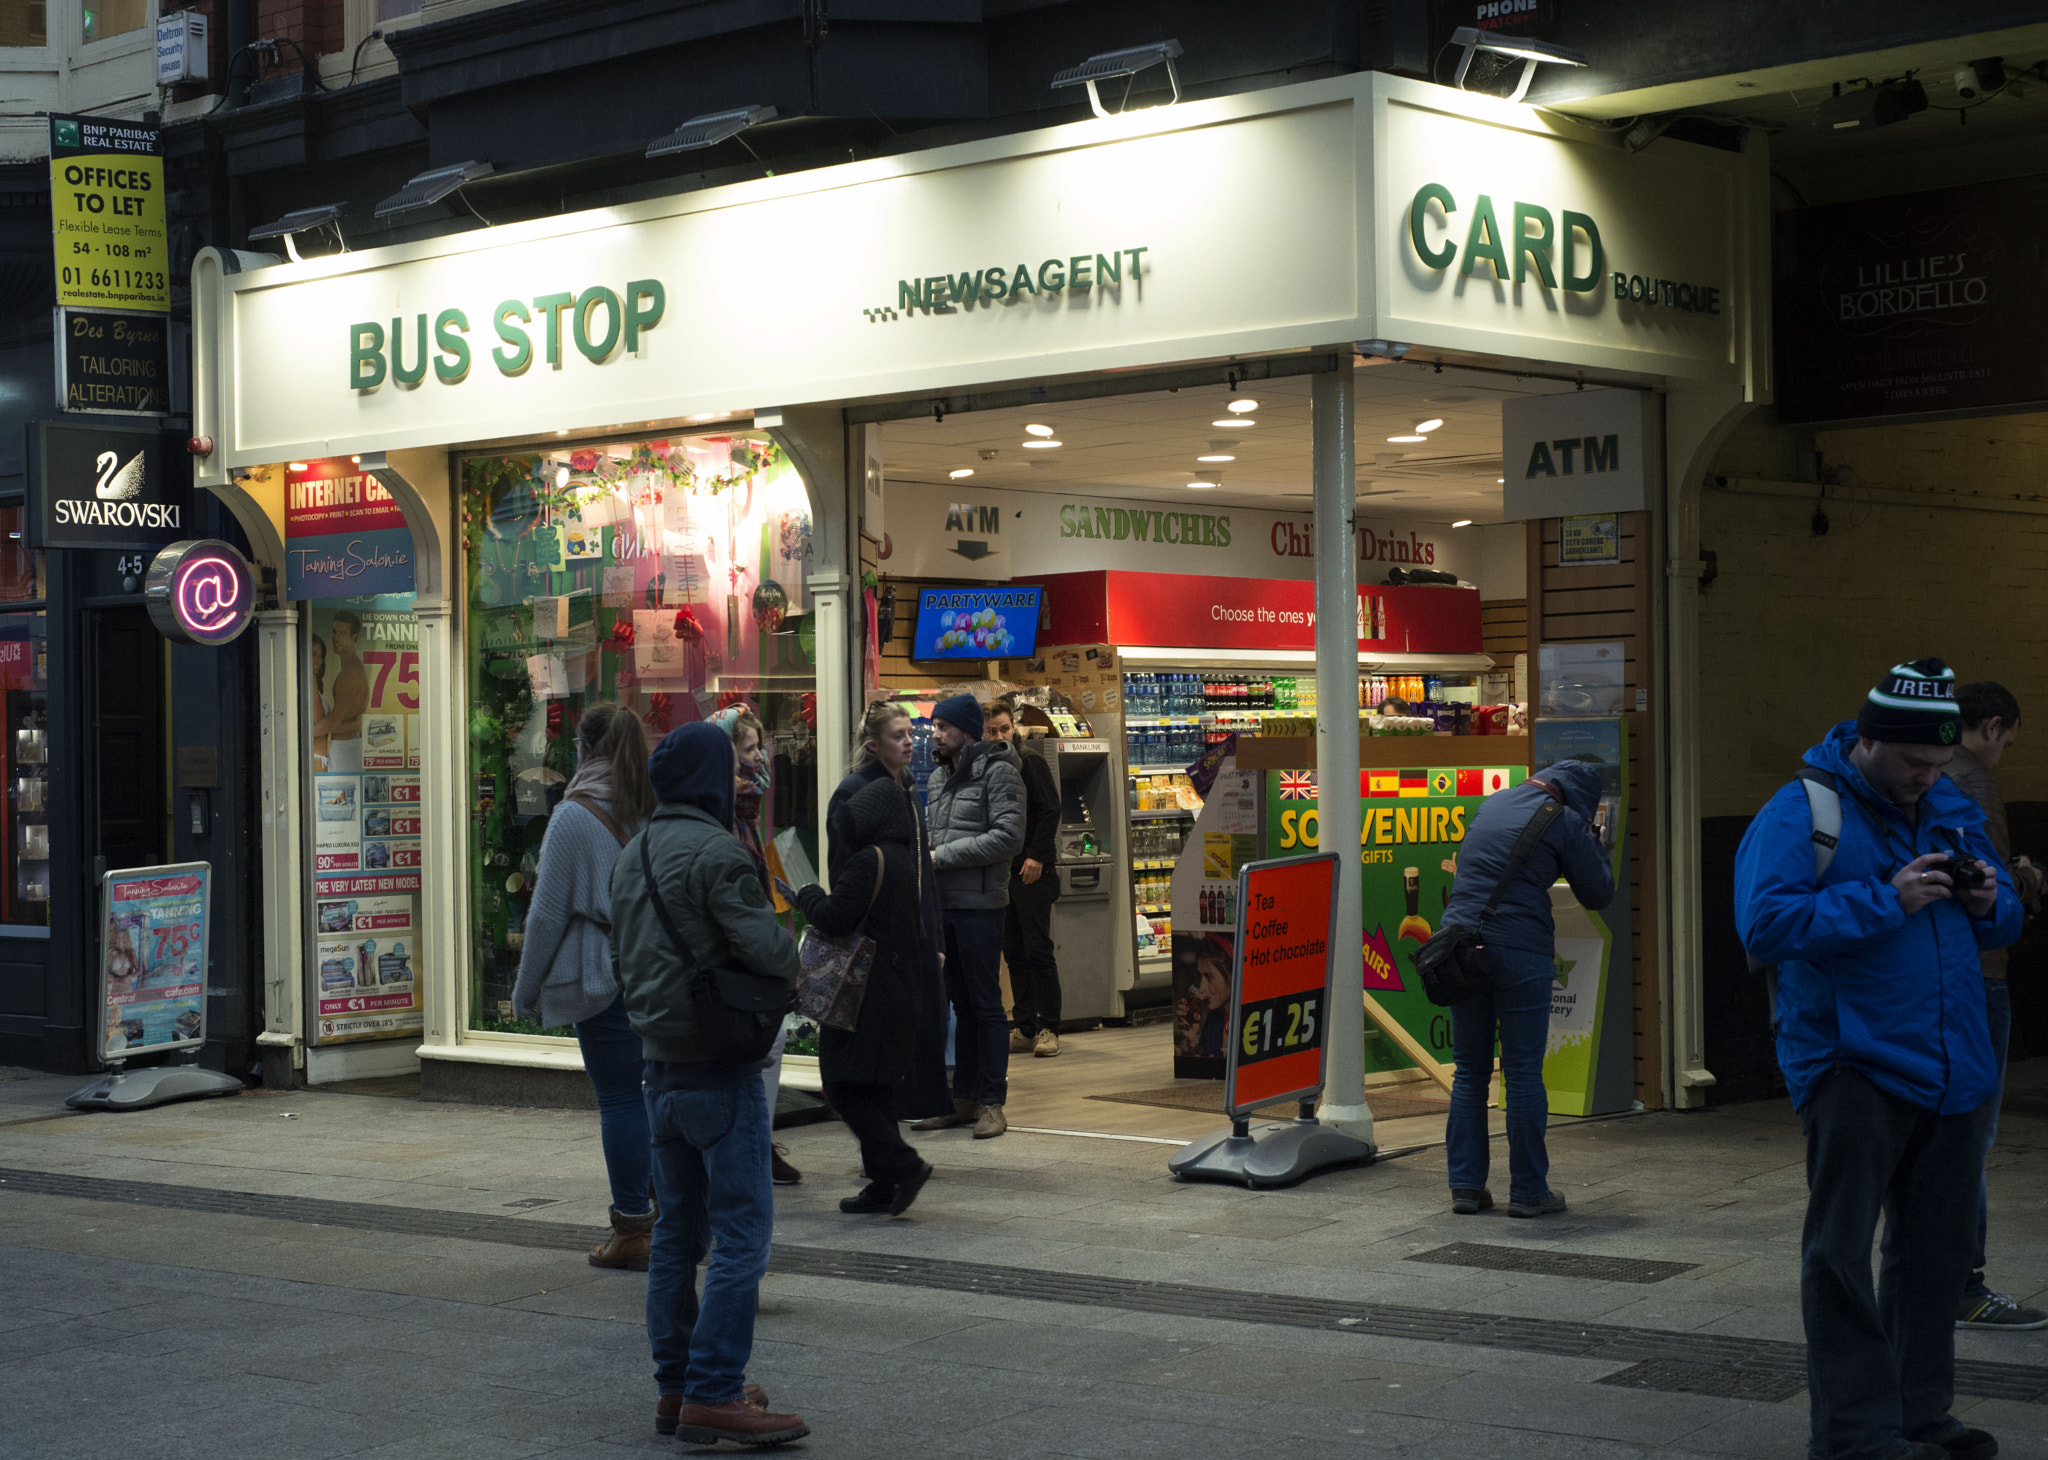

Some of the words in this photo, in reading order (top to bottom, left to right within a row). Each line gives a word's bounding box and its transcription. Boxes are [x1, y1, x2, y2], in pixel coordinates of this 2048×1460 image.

[1477, 0, 1537, 20] PHONE
[157, 27, 184, 42] Deltron
[157, 42, 184, 57] Security
[83, 124, 107, 138] BNP
[109, 128, 157, 141] PARIBAS
[83, 136, 112, 149] REAL
[114, 138, 154, 152] ESTATE
[64, 165, 152, 191] OFFICES
[74, 192, 105, 214] TO
[112, 196, 145, 217] LET
[59, 219, 99, 235] Flexible
[102, 222, 131, 237] Lease
[133, 223, 162, 239] Terms
[73, 242, 90, 255] 54
[105, 244, 130, 257] 108
[1410, 182, 1603, 293] CARD
[1611, 271, 1721, 315] BOUTIQUE
[62, 266, 81, 285] 01
[91, 268, 164, 290] 6611233
[898, 246, 1149, 310] NEWSAGENT
[1858, 252, 1967, 288] LILLIE'S
[63, 289, 165, 302] realestate.bnpparibas.ie
[1840, 277, 1988, 320] BORDELLO
[73, 317, 104, 338] Des
[112, 320, 160, 347] Byrne
[350, 307, 472, 391] BUS
[491, 278, 667, 370] STOP
[80, 355, 156, 378] TAILORING
[1969, 367, 1993, 378] LATE
[1889, 388, 1913, 399] DAYS
[1922, 385, 1948, 396] WEEK
[1525, 433, 1619, 480] ATM
[290, 475, 363, 510] INTERNET
[365, 473, 395, 502] CA
[55, 499, 181, 528] SWAROVSKI
[294, 512, 325, 522] PHOTOCOPY
[329, 510, 345, 519] PRINT
[349, 508, 364, 517] SCAN
[372, 506, 390, 515] EMAIL
[394, 505, 402, 513] FA
[944, 502, 1000, 535] ATM
[1060, 503, 1232, 548] SANDWICHES
[1359, 527, 1435, 566] Drinks
[117, 555, 143, 575] 4-5
[925, 592, 1037, 610] PARTYWARE
[362, 613, 373, 621] LIE
[374, 613, 398, 622] DOWN
[399, 614, 410, 622] OR
[1211, 604, 1254, 623] Choose
[1257, 607, 1276, 623] the
[1278, 611, 1304, 624] ones
[362, 622, 419, 642] TANNI
[1072, 743, 1102, 751] BANKLINK
[393, 787, 410, 800] €1
[394, 820, 411, 833] €1
[1280, 805, 1466, 849] SOVENIRS
[395, 852, 412, 865] €1
[1361, 849, 1393, 865] GIFTS
[316, 881, 329, 893] THE
[331, 880, 349, 892] VERY
[351, 879, 377, 892] LATEST
[379, 878, 395, 890] NEW
[396, 877, 420, 889] MODEL
[150, 903, 202, 920] TANNING
[1255, 893, 1275, 911] Tea
[357, 917, 372, 929] €1
[1252, 919, 1289, 940] Coffee
[320, 944, 349, 954] megaSun
[1250, 948, 1270, 967] Hot
[1273, 939, 1326, 962] chocolate
[1362, 942, 1391, 980] AIRS
[164, 985, 200, 998] cafe.com
[1550, 993, 1577, 1004] ional
[324, 1003, 342, 1011] ONLY
[348, 998, 365, 1010] €1
[384, 998, 409, 1006] MINUTE
[1550, 1004, 1573, 1018] tery
[336, 1021, 362, 1031] STRICTLY
[363, 1020, 380, 1028] OVER
[1242, 999, 1317, 1057] €1.25
